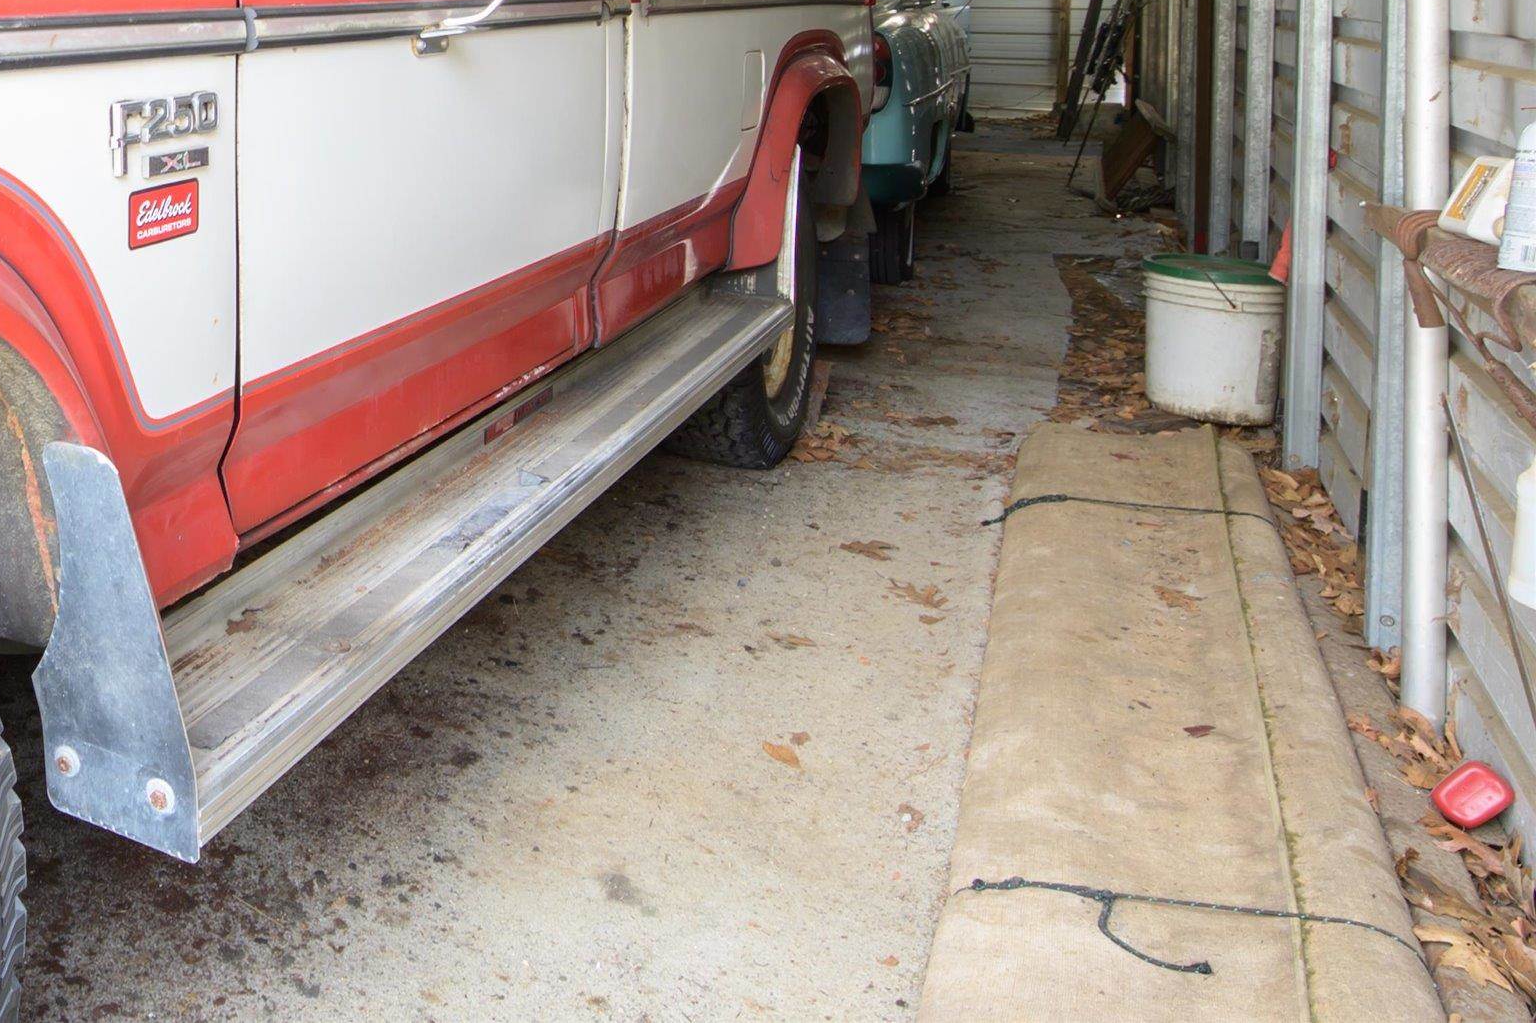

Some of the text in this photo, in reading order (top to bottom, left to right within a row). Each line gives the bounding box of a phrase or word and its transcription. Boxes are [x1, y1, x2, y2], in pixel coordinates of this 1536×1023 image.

[160, 151, 201, 173] XL
[136, 192, 192, 227] Edelbrock
[136, 217, 192, 240] CARBURETORS
